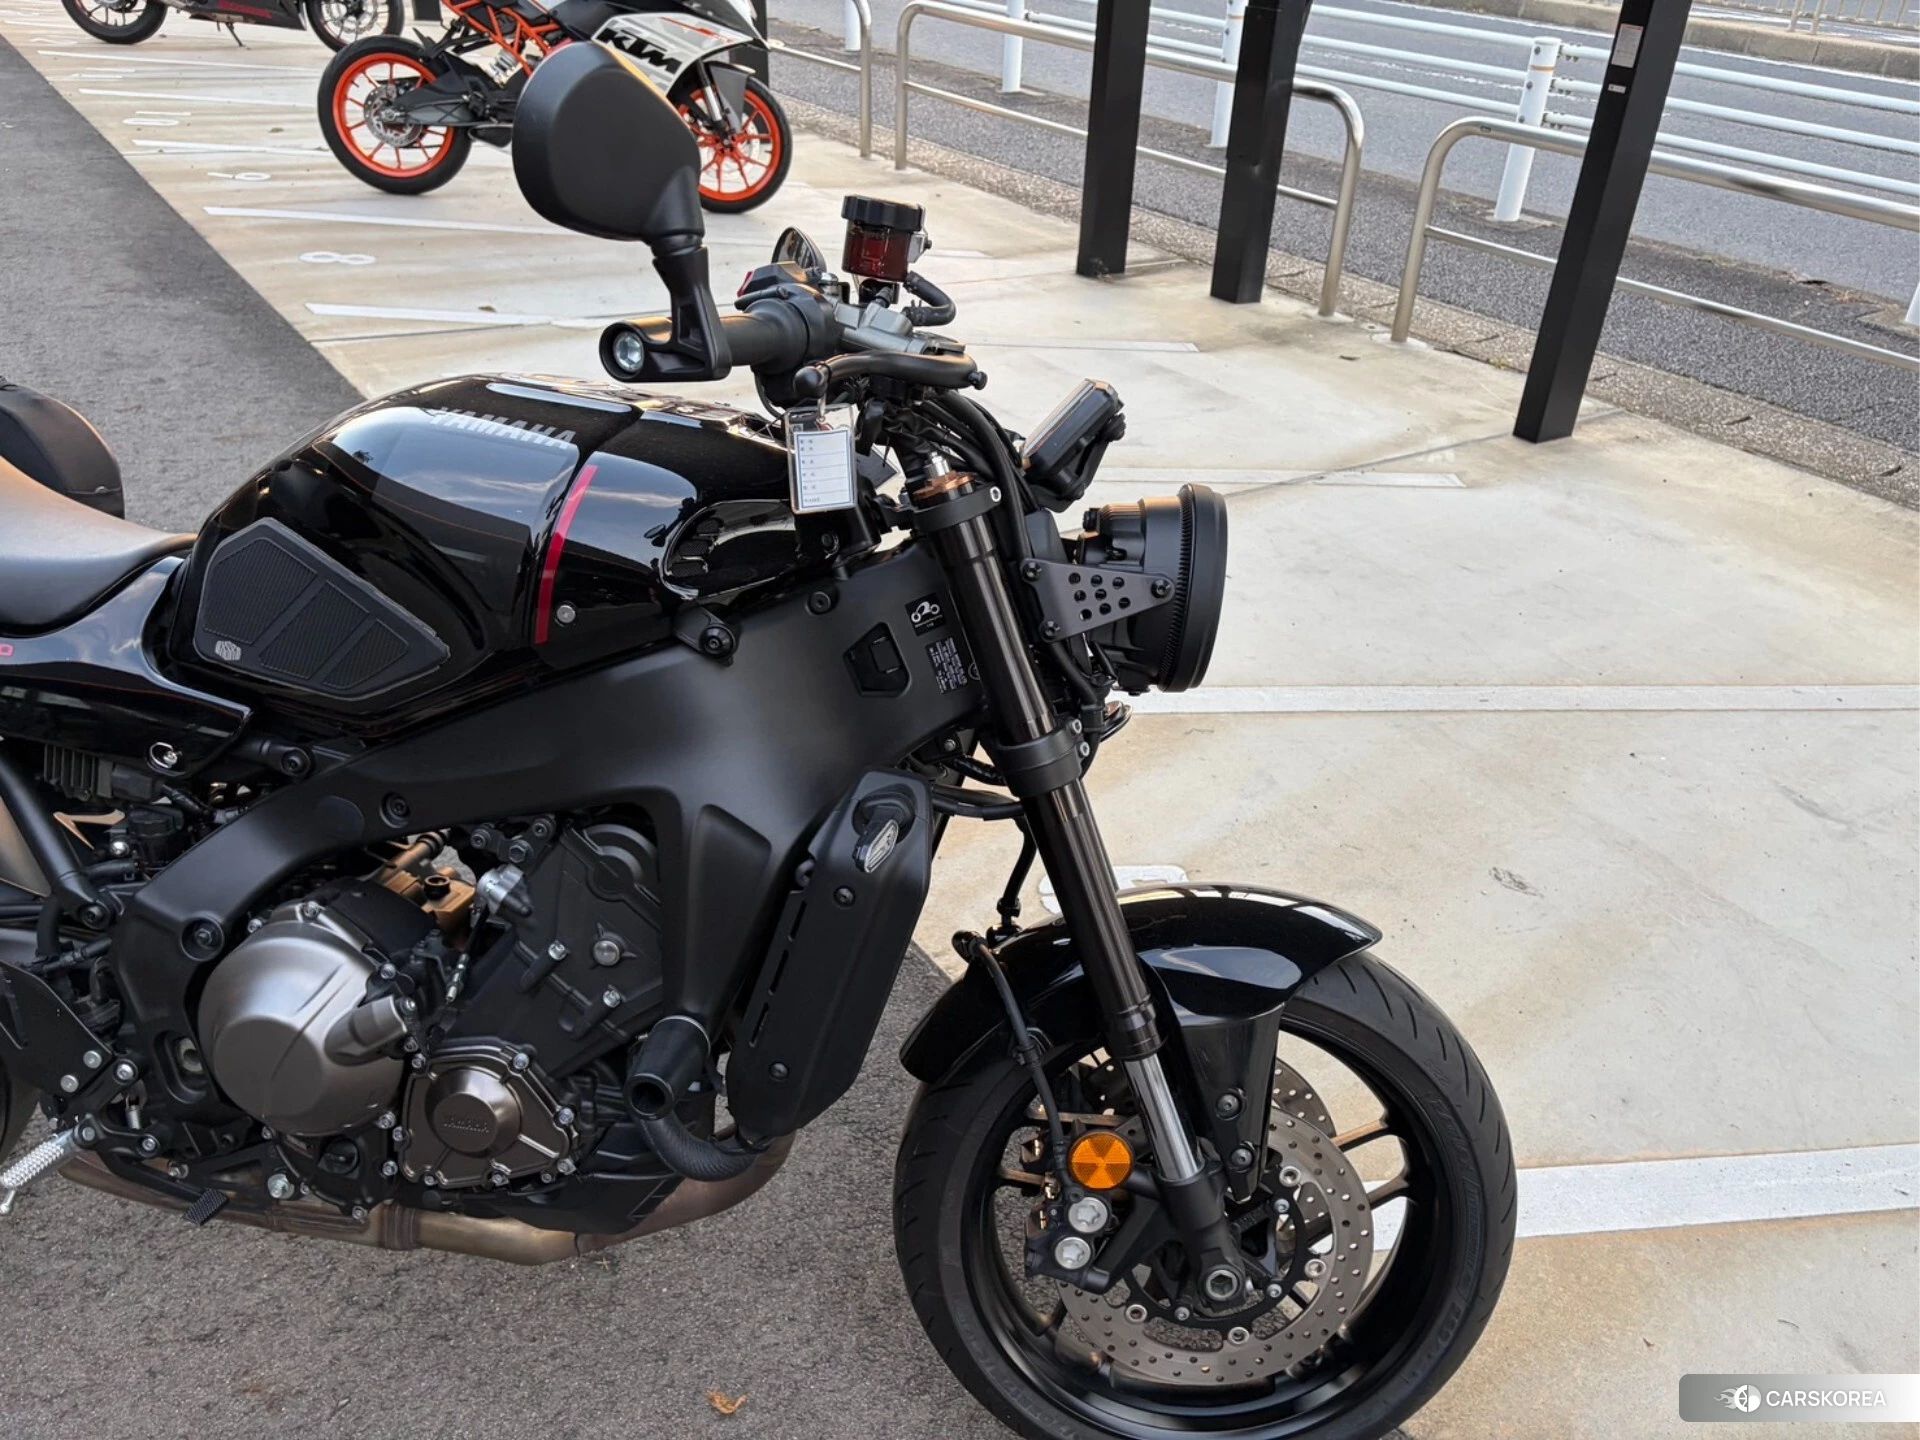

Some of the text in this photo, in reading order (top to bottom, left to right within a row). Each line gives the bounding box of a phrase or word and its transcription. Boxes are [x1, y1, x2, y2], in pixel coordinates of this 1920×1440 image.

[596, 27, 682, 75] KTM
[299, 251, 376, 265] 8
[429, 406, 577, 450] YAMAHA
